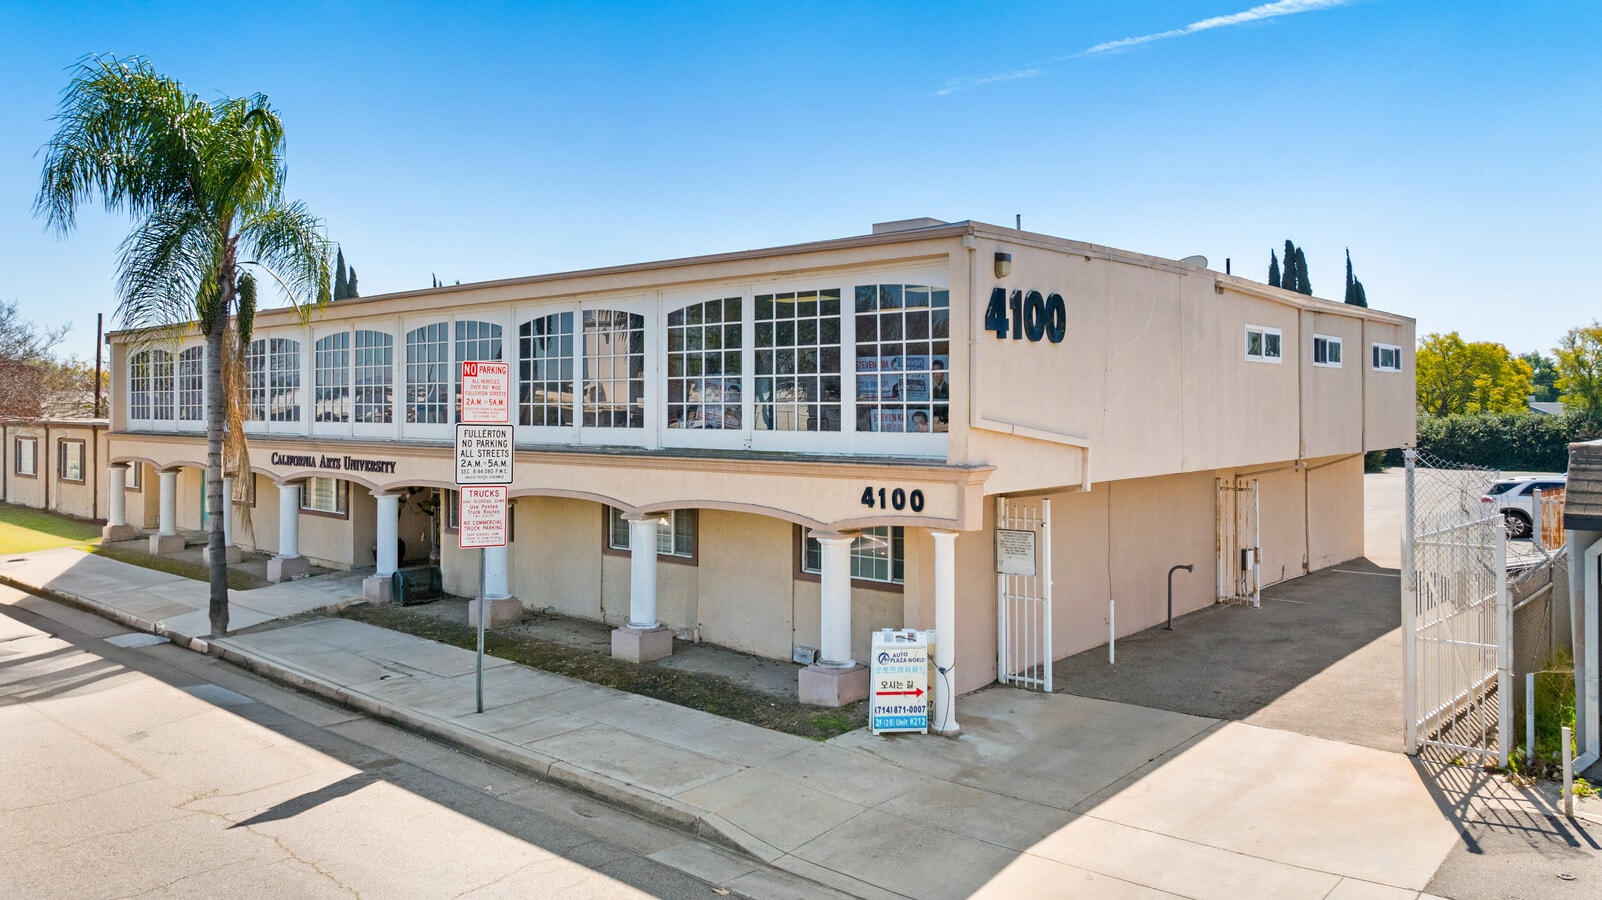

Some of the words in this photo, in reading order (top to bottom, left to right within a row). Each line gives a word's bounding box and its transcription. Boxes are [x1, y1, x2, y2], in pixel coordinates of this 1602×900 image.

[984, 288, 1066, 344] 4100
[464, 363, 477, 376] NO
[480, 366, 506, 374] PARKING
[874, 413, 896, 422] SEVEN
[464, 430, 506, 438] FULLERTON
[476, 440, 508, 448] PARKING
[271, 452, 316, 468] CALIFORNIA
[319, 454, 341, 470] ARTS
[343, 456, 396, 474] UNIVERSITY
[460, 459, 482, 467] 2A.M.
[488, 459, 508, 467] 5A.M.
[861, 486, 925, 512] 4100
[881, 680, 903, 689] 오시는
[906, 681, 914, 689] 길
